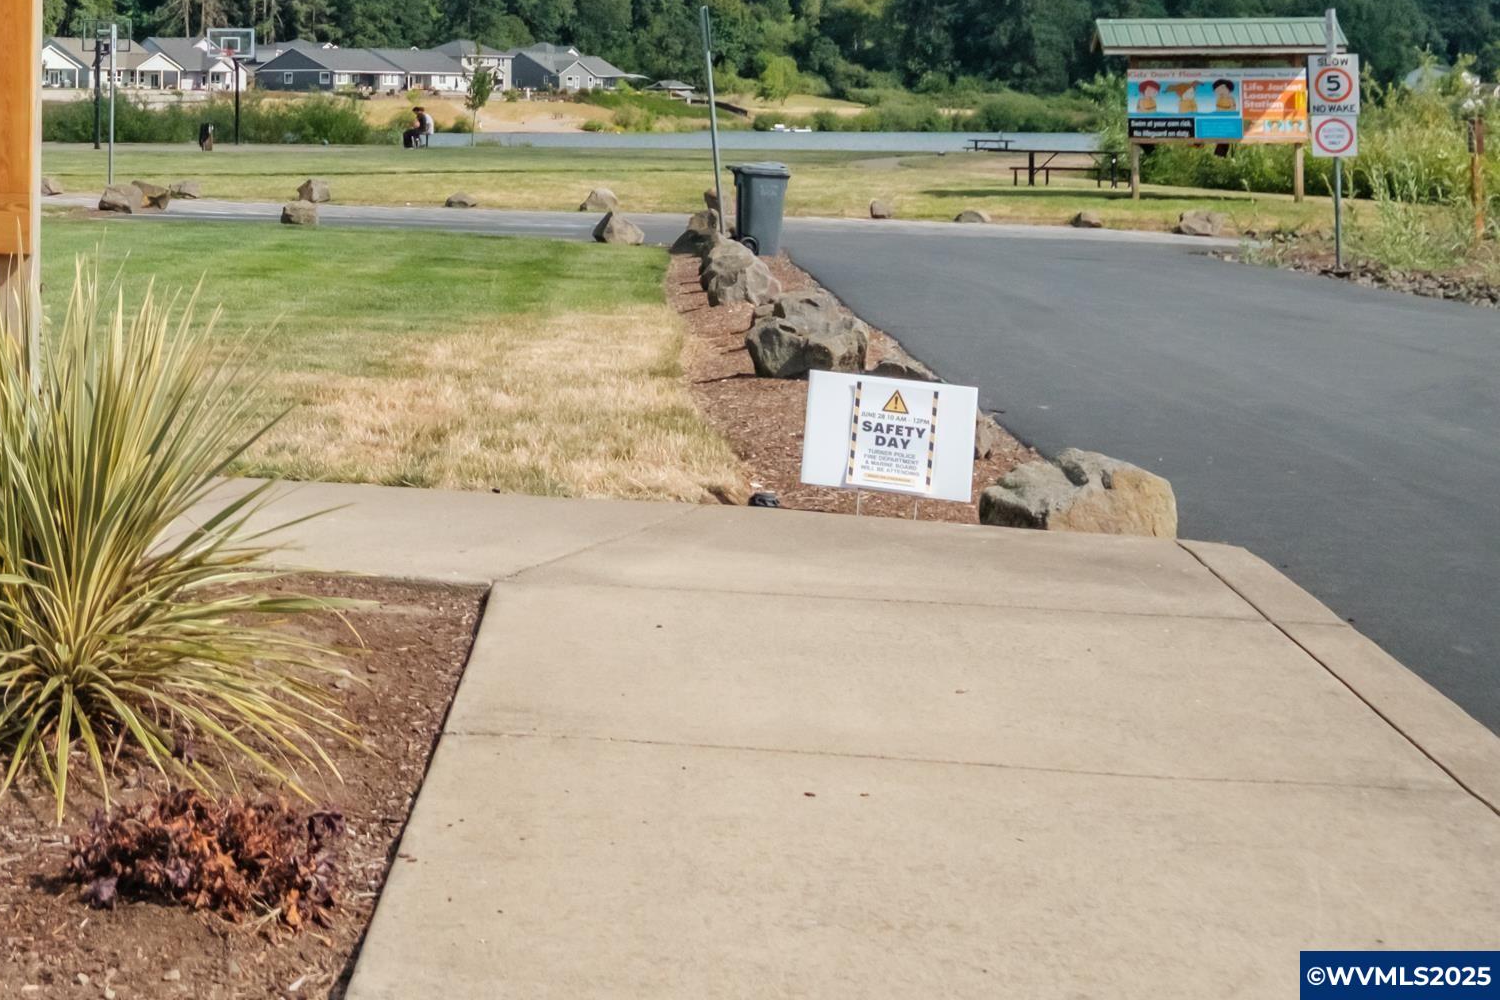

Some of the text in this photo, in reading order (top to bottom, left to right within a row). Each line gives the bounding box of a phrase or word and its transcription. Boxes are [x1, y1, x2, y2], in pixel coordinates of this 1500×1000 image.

[1317, 57, 1349, 67] SLOW
[1244, 83, 1303, 91] Life Jacket
[1327, 75, 1341, 91] 5
[1244, 100, 1285, 109] Station
[1312, 103, 1356, 113] NO WAKE
[1143, 130, 1168, 138] lifeguard
[913, 417, 930, 425] 12PM
[862, 420, 926, 439] SAFETY
[875, 435, 911, 450] DAY
[868, 448, 916, 459] TURNER POLICE
[879, 455, 920, 465] DEPARTMENT
[895, 463, 918, 471] BOARD
[886, 468, 920, 477] ATTENDING
